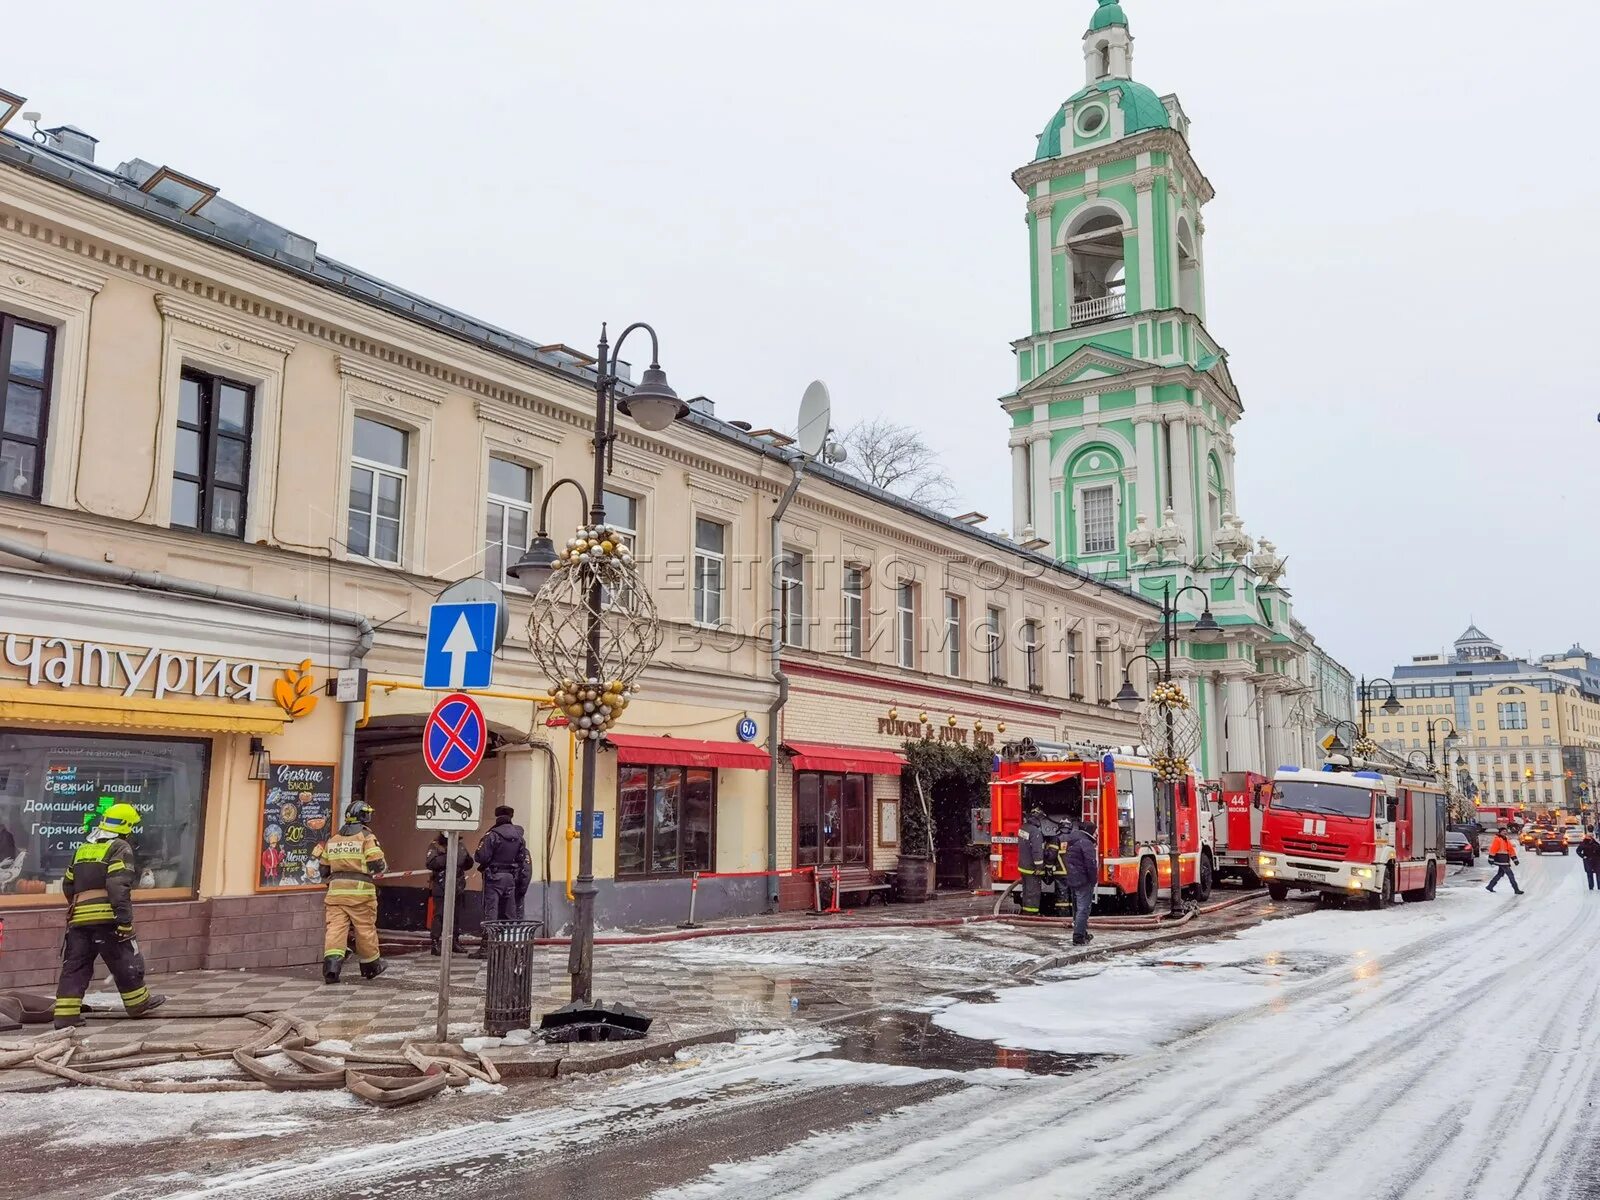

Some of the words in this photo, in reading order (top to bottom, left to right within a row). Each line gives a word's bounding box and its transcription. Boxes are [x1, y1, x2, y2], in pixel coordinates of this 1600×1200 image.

[742, 721, 755, 735] 6/1
[877, 718, 922, 739] PUNCH
[926, 723, 936, 740] &
[938, 725, 968, 744] JUDY
[44, 780, 94, 792] Свежий
[102, 784, 141, 793] лаваш
[287, 781, 314, 791] БЛЮДА
[23, 799, 95, 813] Домашние
[1231, 794, 1245, 806] 44
[31, 823, 86, 838] Горячие
